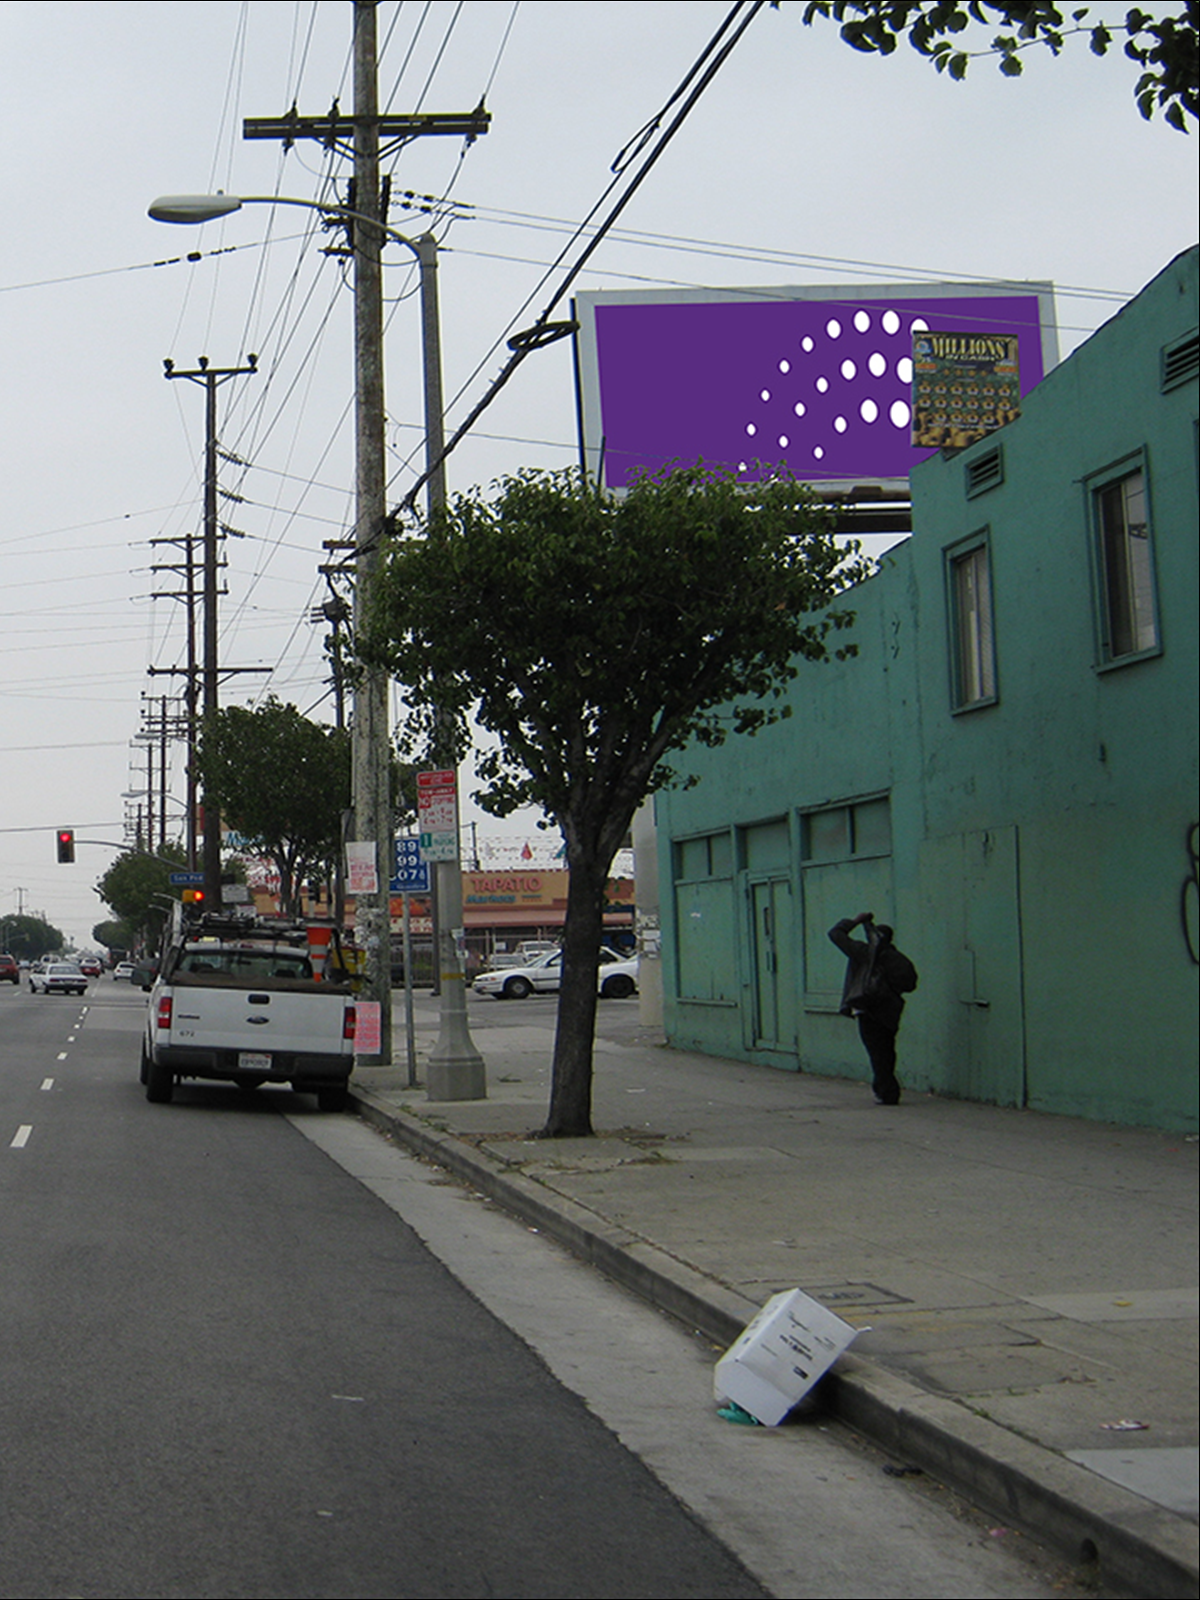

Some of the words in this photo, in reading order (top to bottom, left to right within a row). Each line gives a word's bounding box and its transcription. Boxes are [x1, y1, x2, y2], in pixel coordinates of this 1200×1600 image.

[932, 337, 1006, 360] MILLIONS
[397, 855, 418, 866] 99
[471, 876, 543, 893] TAPATIO
